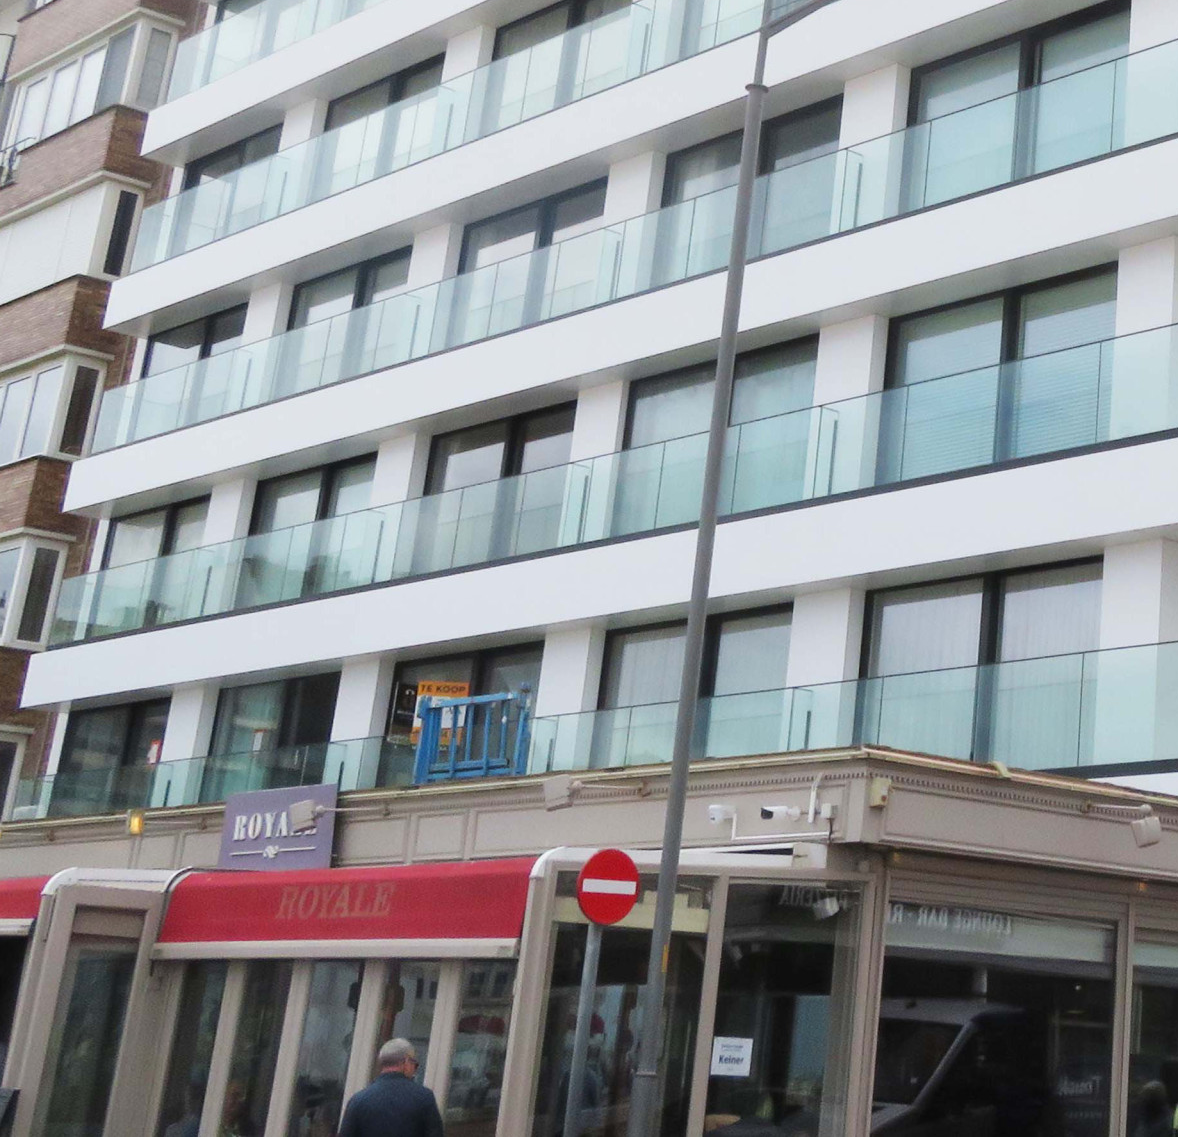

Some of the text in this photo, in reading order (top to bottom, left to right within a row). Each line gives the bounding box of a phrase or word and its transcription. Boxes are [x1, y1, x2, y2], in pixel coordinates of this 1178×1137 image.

[420, 684, 467, 694] TE KOOP
[232, 810, 318, 842] ROYA
[275, 880, 397, 920] ROYALE
